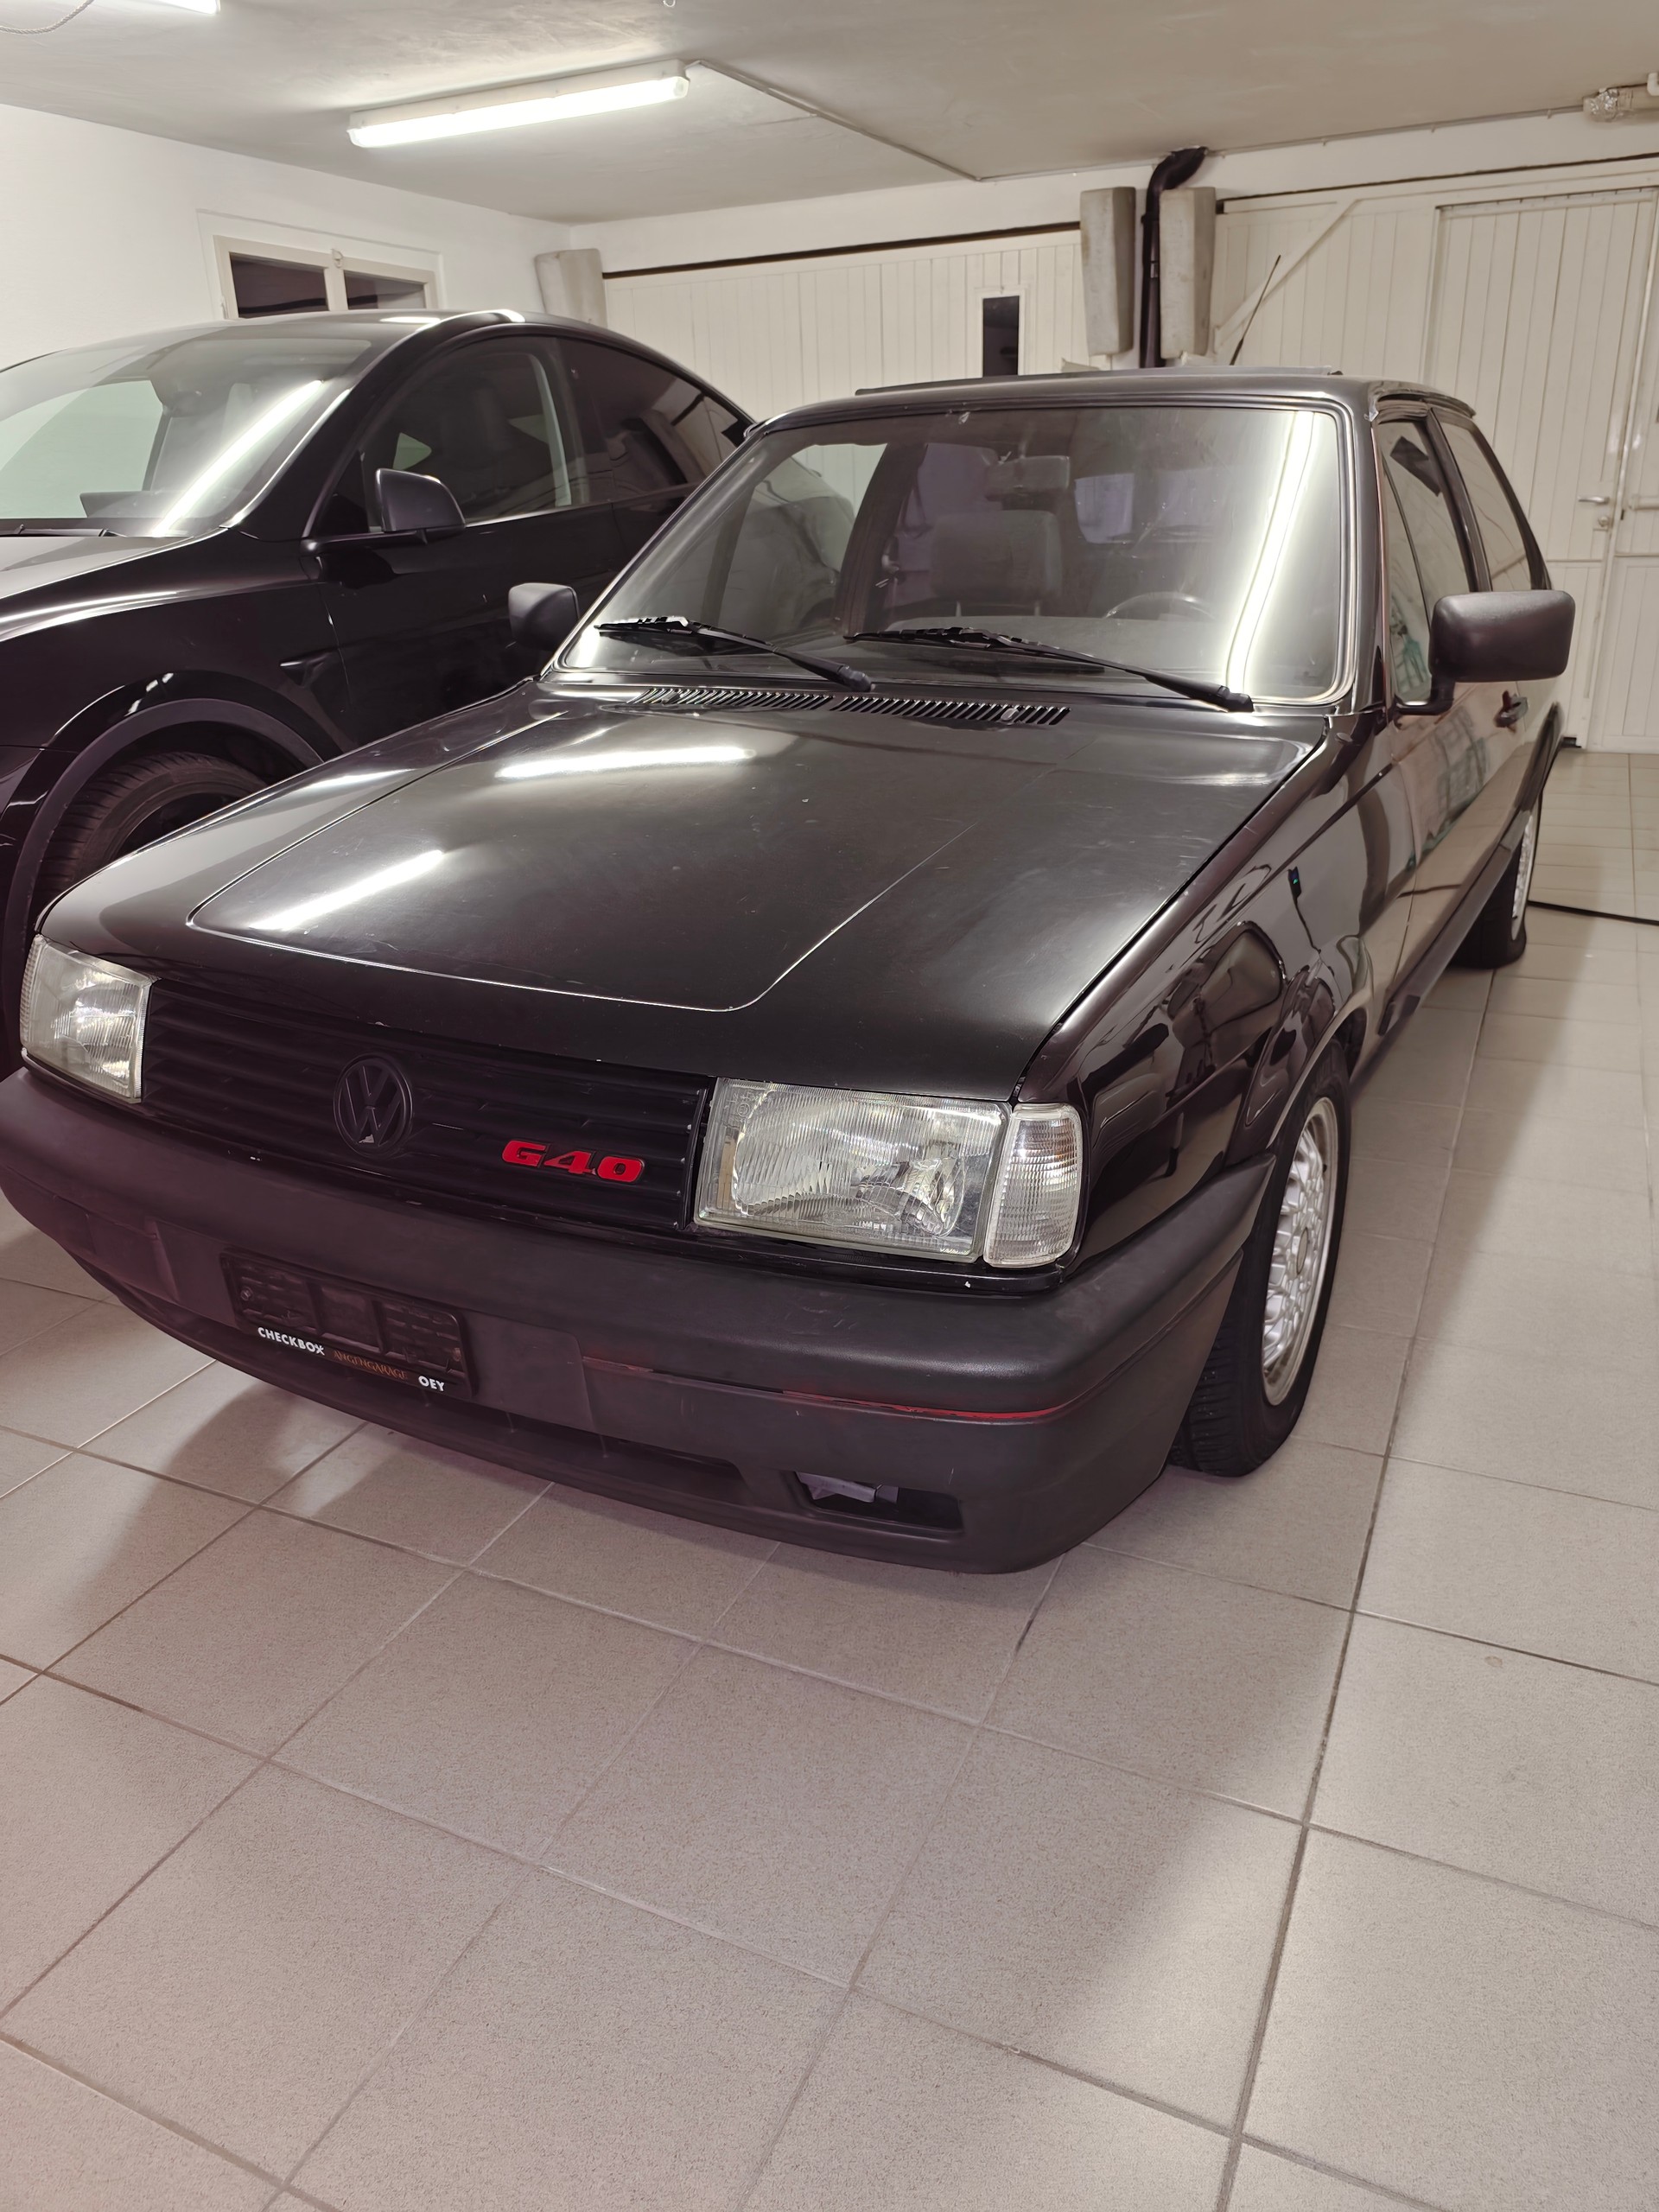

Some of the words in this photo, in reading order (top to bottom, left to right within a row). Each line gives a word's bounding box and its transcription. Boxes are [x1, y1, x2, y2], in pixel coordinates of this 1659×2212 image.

[337, 1057, 409, 1152] VW
[501, 1140, 645, 1183] G40
[257, 1326, 325, 1356] CHECKBOX
[418, 1375, 445, 1392] OEY
